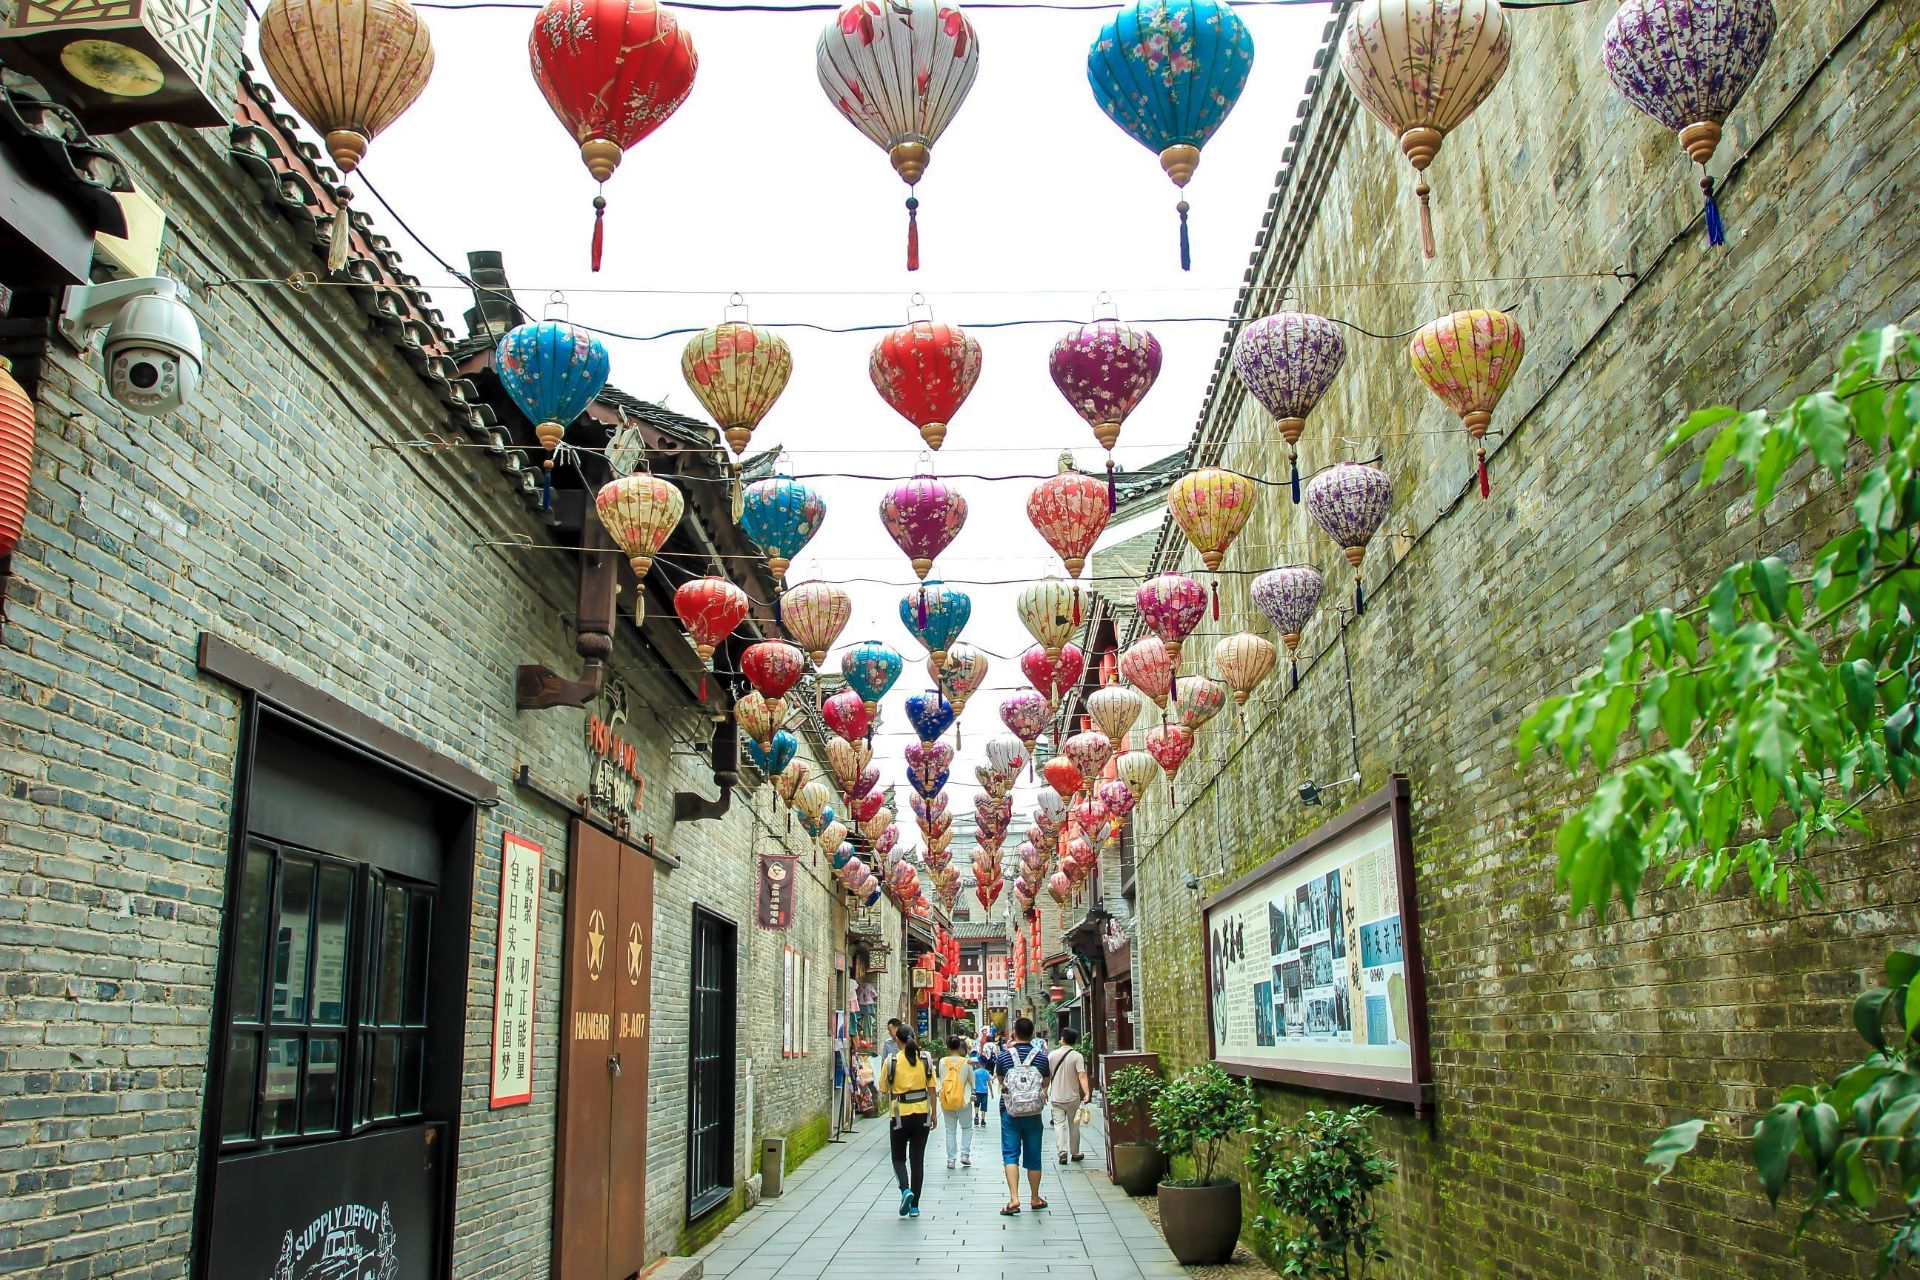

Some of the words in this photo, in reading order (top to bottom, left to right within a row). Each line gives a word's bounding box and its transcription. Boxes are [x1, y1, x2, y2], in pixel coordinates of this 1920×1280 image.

[590, 712, 611, 756] FISH
[614, 776, 631, 817] BAR
[635, 774, 644, 811] 2
[501, 861, 519, 1081] 早日实现中国梦
[516, 865, 535, 1080] 凝聚一切正能量
[575, 1011, 610, 1041] HANGAR
[619, 1012, 646, 1038] JB-A07
[295, 1206, 343, 1260] SUPPLY
[345, 1204, 379, 1234] DEPOT
